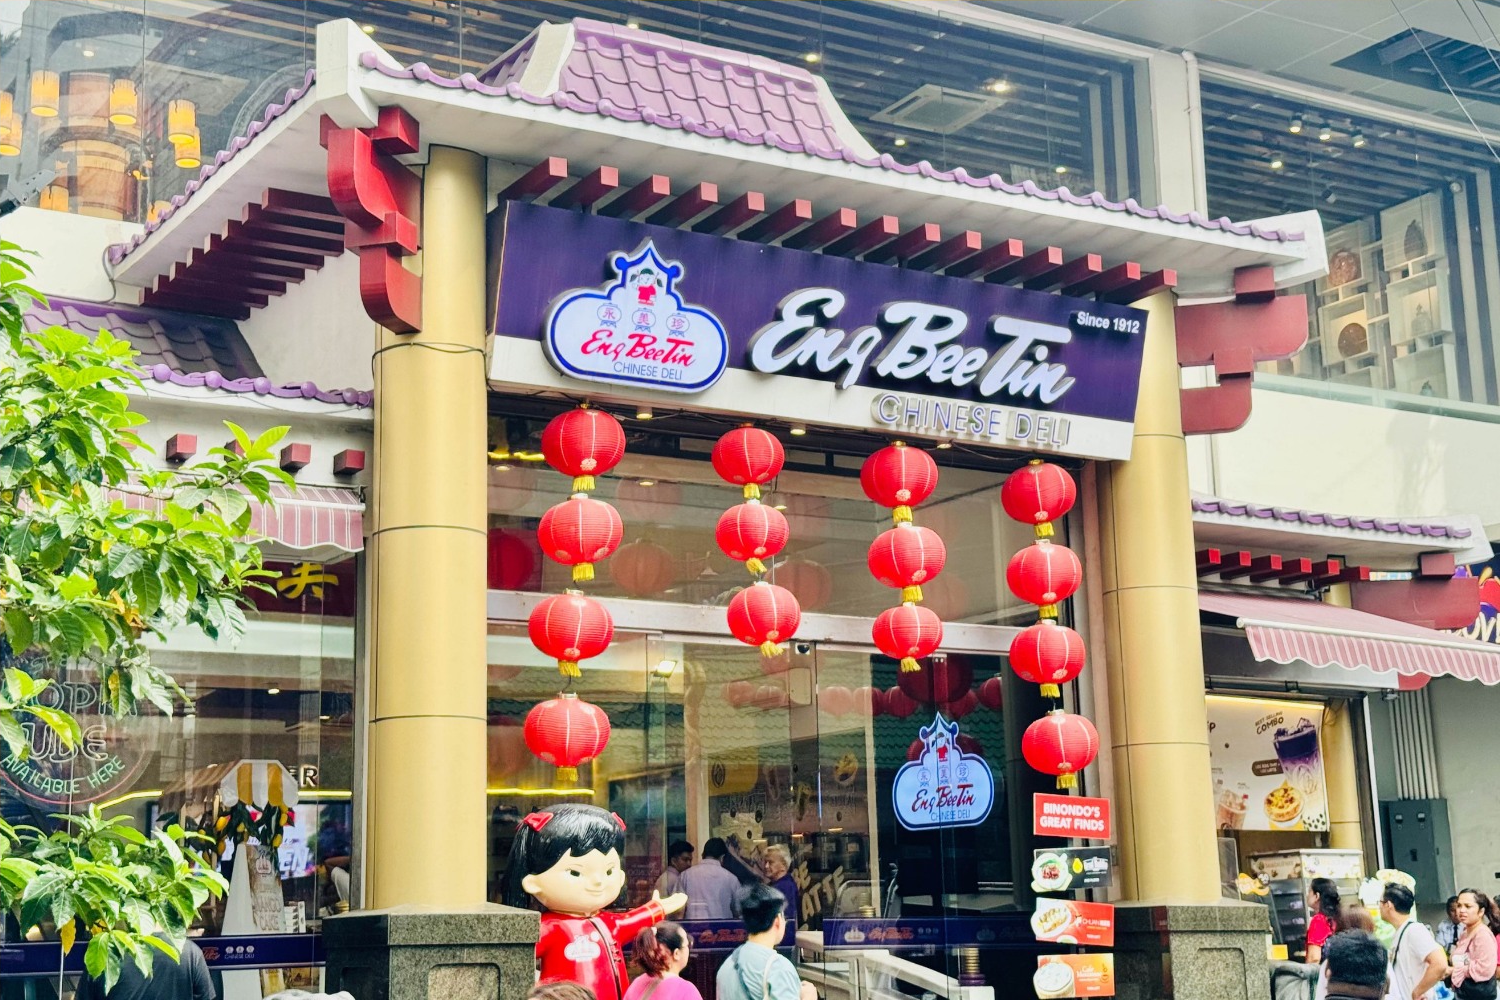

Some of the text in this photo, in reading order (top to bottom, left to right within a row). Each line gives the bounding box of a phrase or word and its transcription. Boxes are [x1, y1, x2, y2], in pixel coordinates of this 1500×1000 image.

[1077, 311, 1140, 334] Since 1912
[581, 329, 625, 362] Eng
[750, 287, 1076, 404] Eng Bee Tin
[613, 361, 683, 381] CHINESE DELI
[877, 394, 1072, 446] CHINESE DELI
[1256, 716, 1284, 735] COMBO
[0, 753, 126, 795] AVAILABLE HERE
[911, 788, 936, 815] Eng
[1043, 802, 1101, 818] BINONDO'S
[930, 809, 971, 821] CHINESE DELI
[1039, 816, 1105, 831] GREAT FINDS
[798, 864, 845, 931] ATTE
